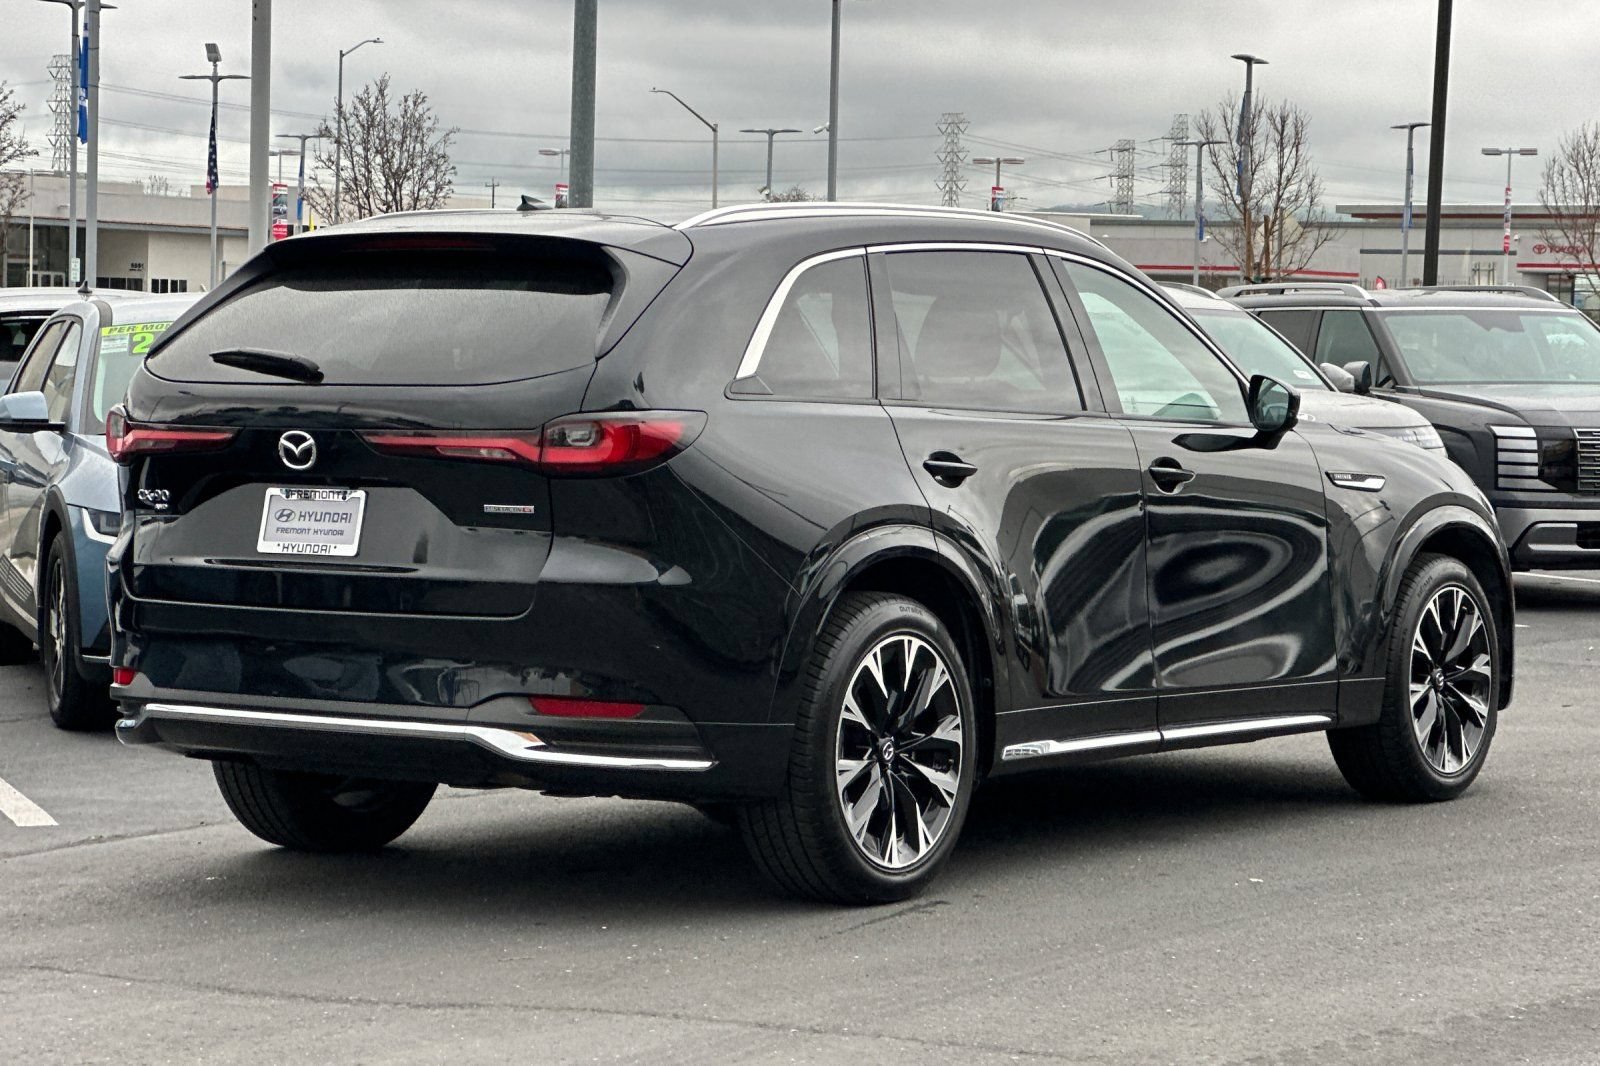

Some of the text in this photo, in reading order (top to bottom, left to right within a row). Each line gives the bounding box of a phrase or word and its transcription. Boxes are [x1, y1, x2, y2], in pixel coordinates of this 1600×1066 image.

[107, 326, 136, 335] PER
[290, 490, 341, 499] FREMONT
[298, 511, 352, 523] HYUNDAI
[276, 527, 311, 535] FREMONT
[282, 543, 331, 554] HYUNDAI
